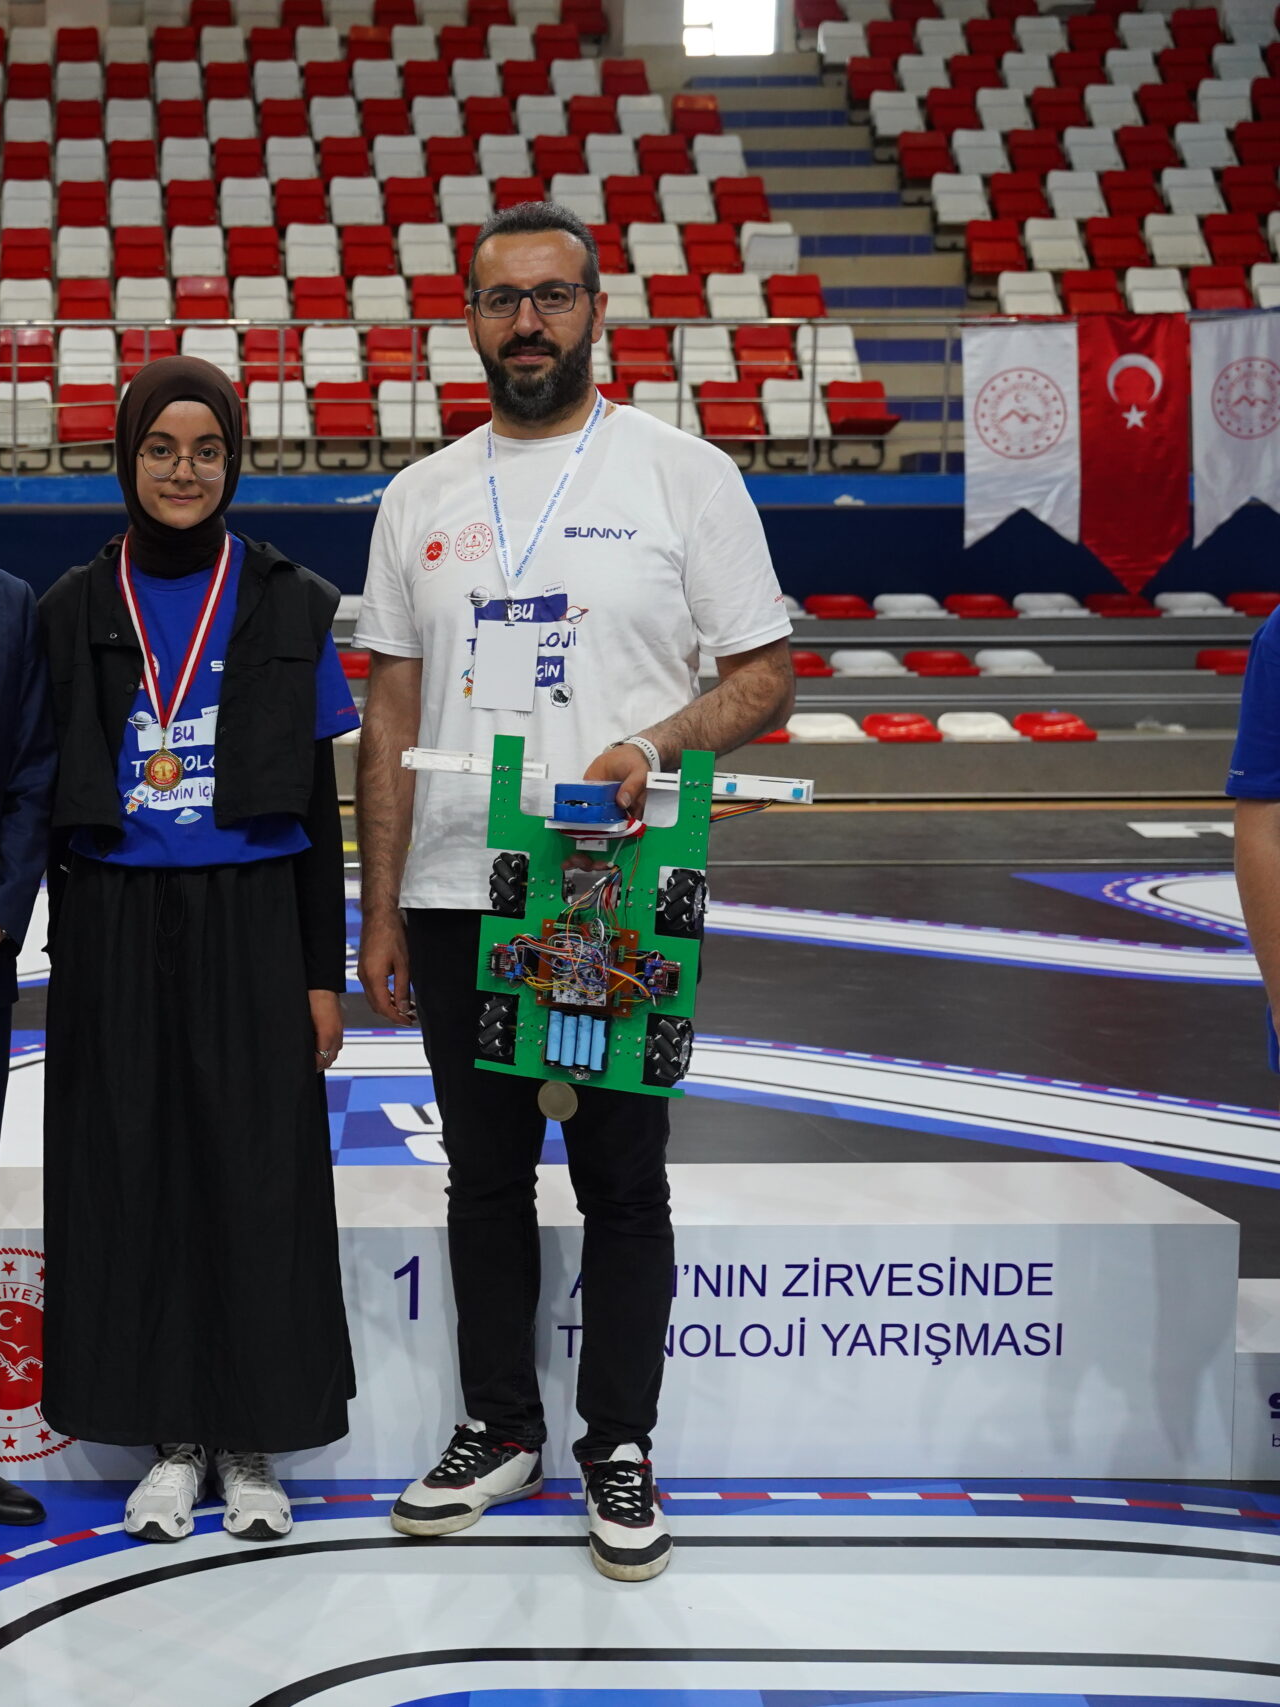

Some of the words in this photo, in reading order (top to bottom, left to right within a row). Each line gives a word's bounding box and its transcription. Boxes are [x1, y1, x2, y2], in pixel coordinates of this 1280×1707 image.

[563, 527, 638, 540] SUNNY
[172, 726, 195, 743] BU
[152, 786, 194, 803] SENİN
[393, 1255, 420, 1321] 1
[782, 1256, 1054, 1298] ZİRVESİNDE
[821, 1322, 1063, 1366] YARIŞMASI
